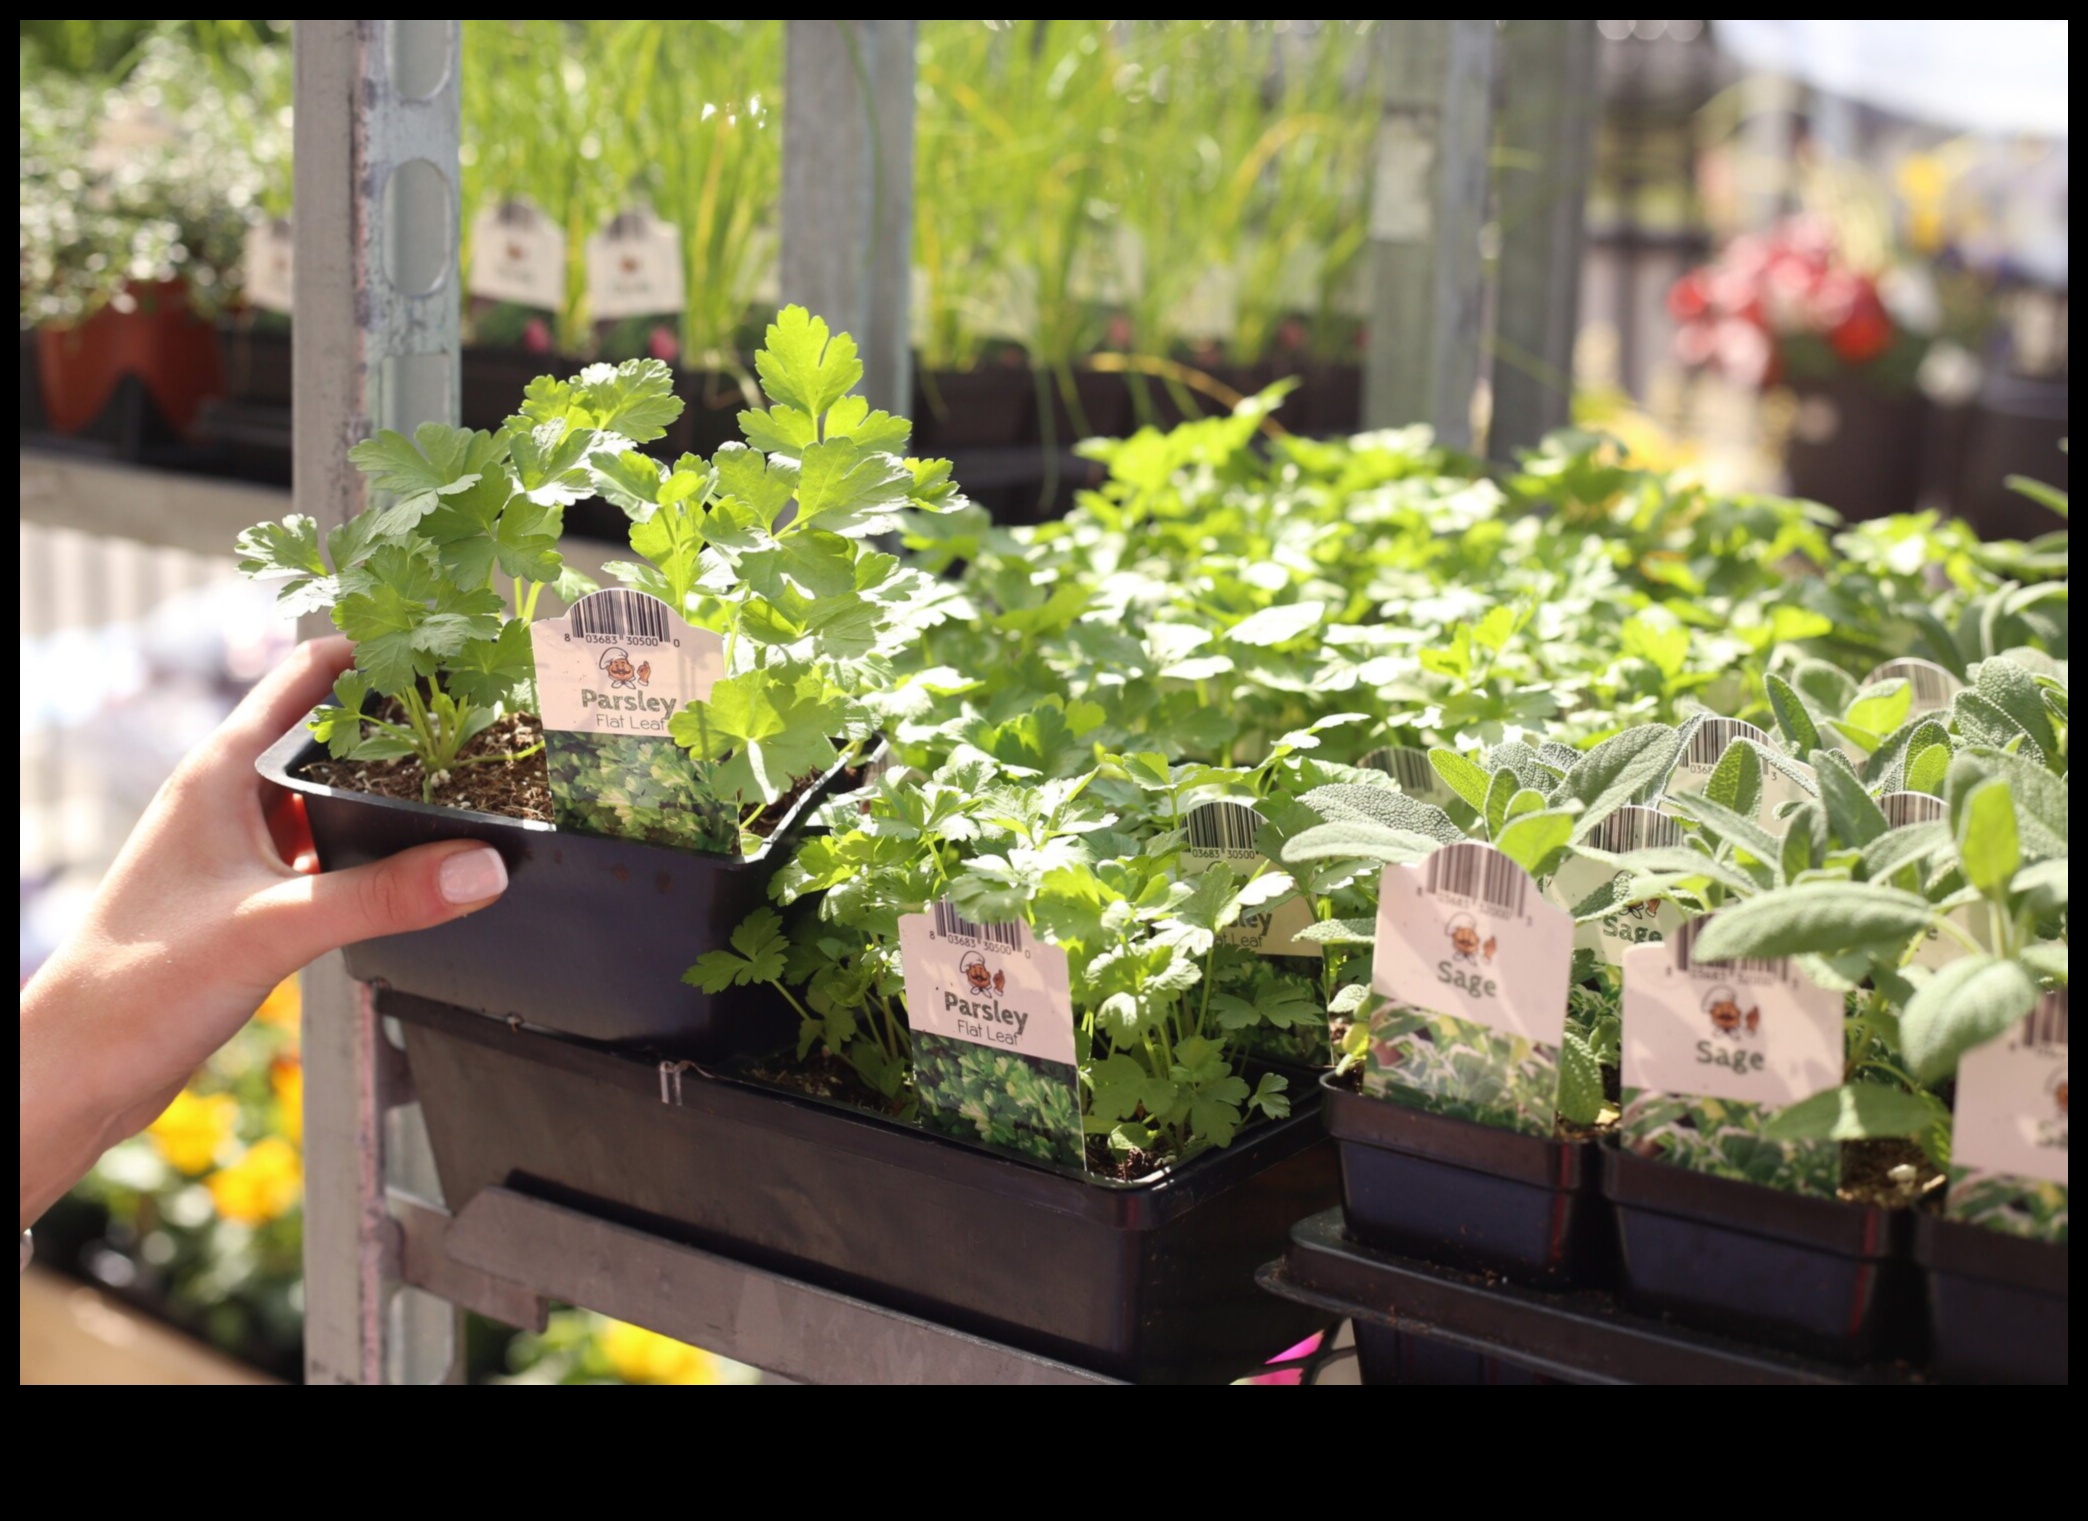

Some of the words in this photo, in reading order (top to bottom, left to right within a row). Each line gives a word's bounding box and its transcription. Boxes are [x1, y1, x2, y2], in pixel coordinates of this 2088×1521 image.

[564, 633, 571, 643] 8
[585, 634, 618, 645] 03683
[626, 636, 659, 648] 30500
[673, 638, 680, 648] 0
[581, 688, 677, 720] Parsley
[596, 713, 624, 729] Flat
[630, 715, 665, 731] Leaf
[1690, 764, 1713, 775] 0368
[1192, 848, 1220, 859] 03683
[1227, 849, 1256, 860] 30500
[929, 930, 936, 940] 8
[947, 933, 977, 949] 03683
[983, 940, 1012, 956] 30500
[1024, 950, 1031, 960] 0
[1437, 960, 1497, 998] Sage
[943, 990, 1029, 1036] Parsley
[957, 1019, 984, 1039] Flat
[986, 1025, 1020, 1046] Leaf
[1696, 1040, 1765, 1075] Sage
